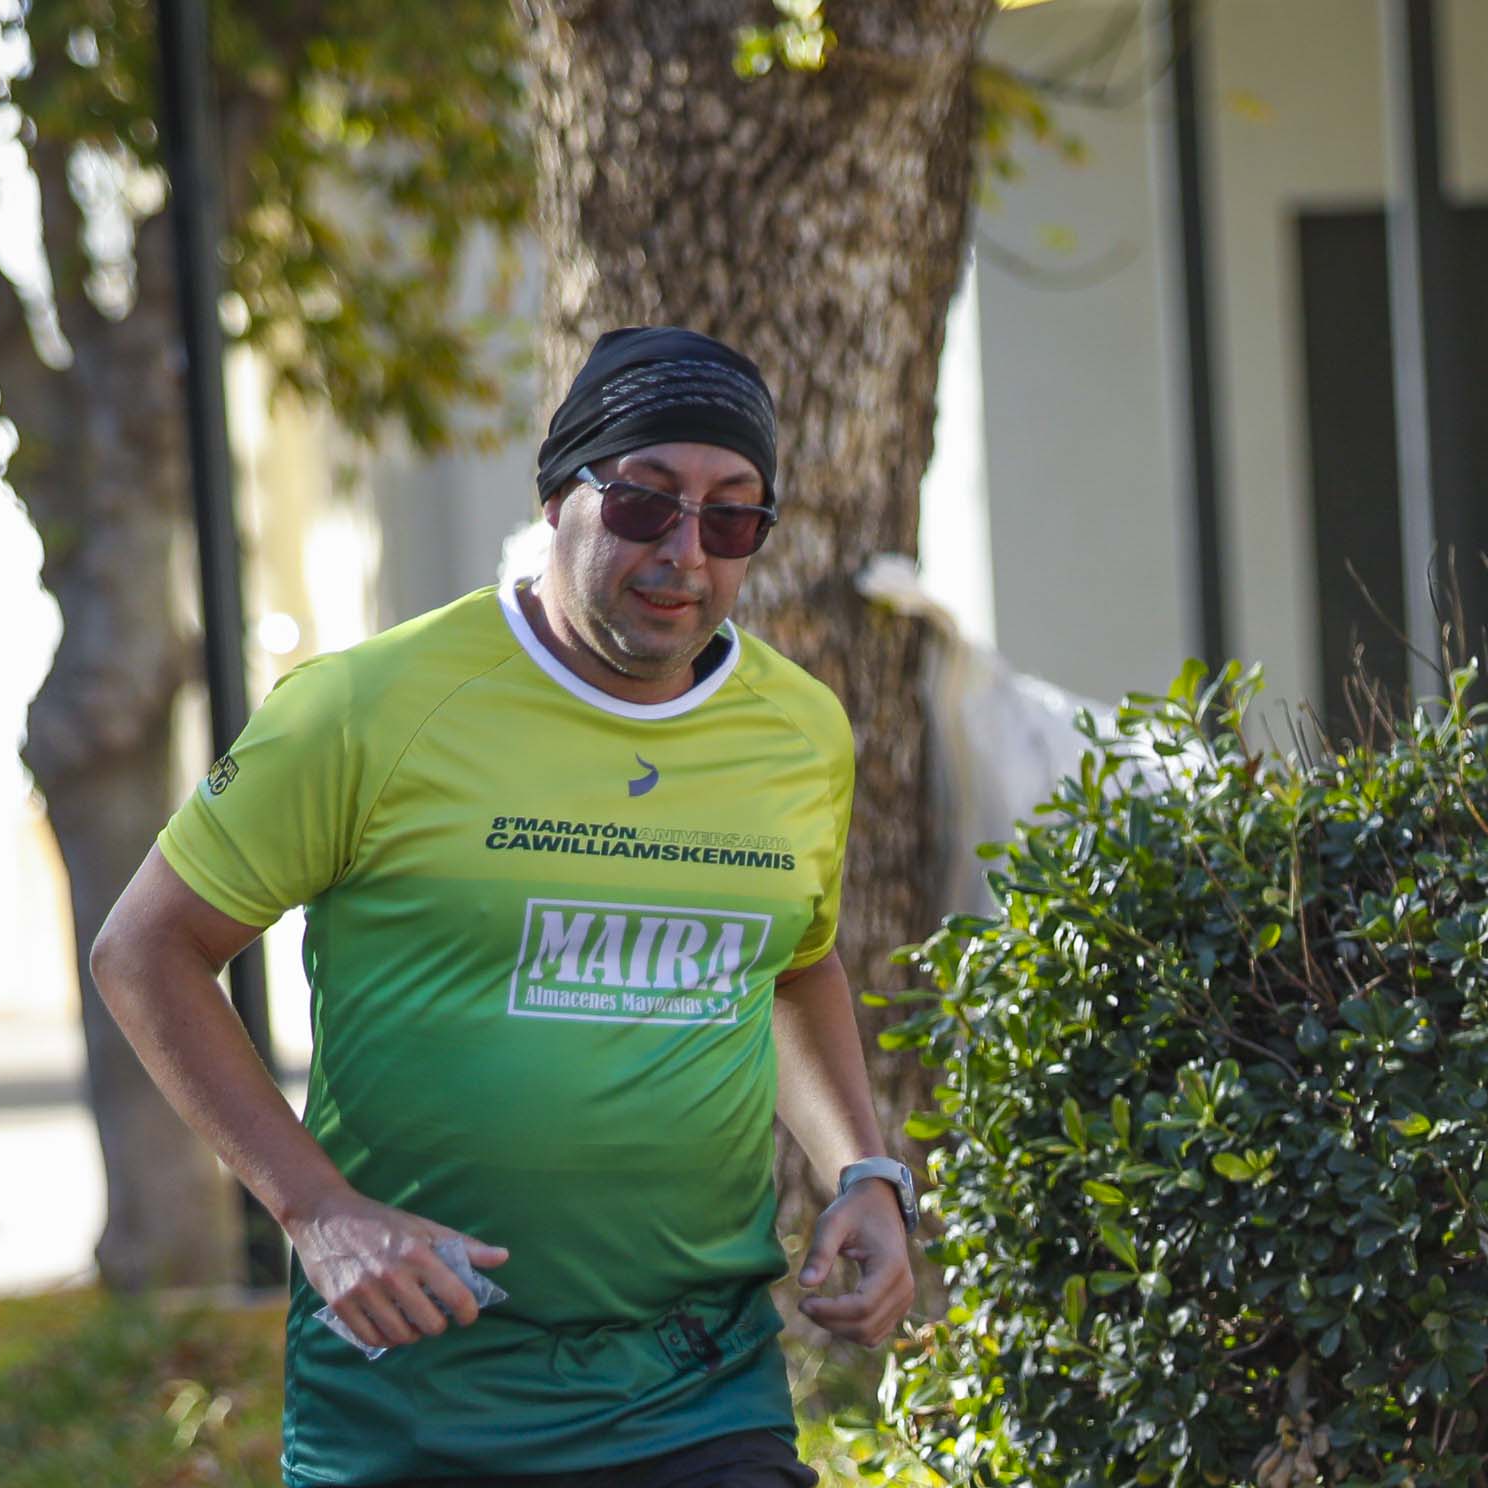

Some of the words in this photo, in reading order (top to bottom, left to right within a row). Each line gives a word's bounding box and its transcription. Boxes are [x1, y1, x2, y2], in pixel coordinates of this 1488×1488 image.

[485, 832, 796, 871] CAWILLIAMSKEMMIS
[528, 910, 745, 993] MAIRA
[525, 985, 616, 1011] Almacenes
[622, 992, 703, 1014] Mayoristas
